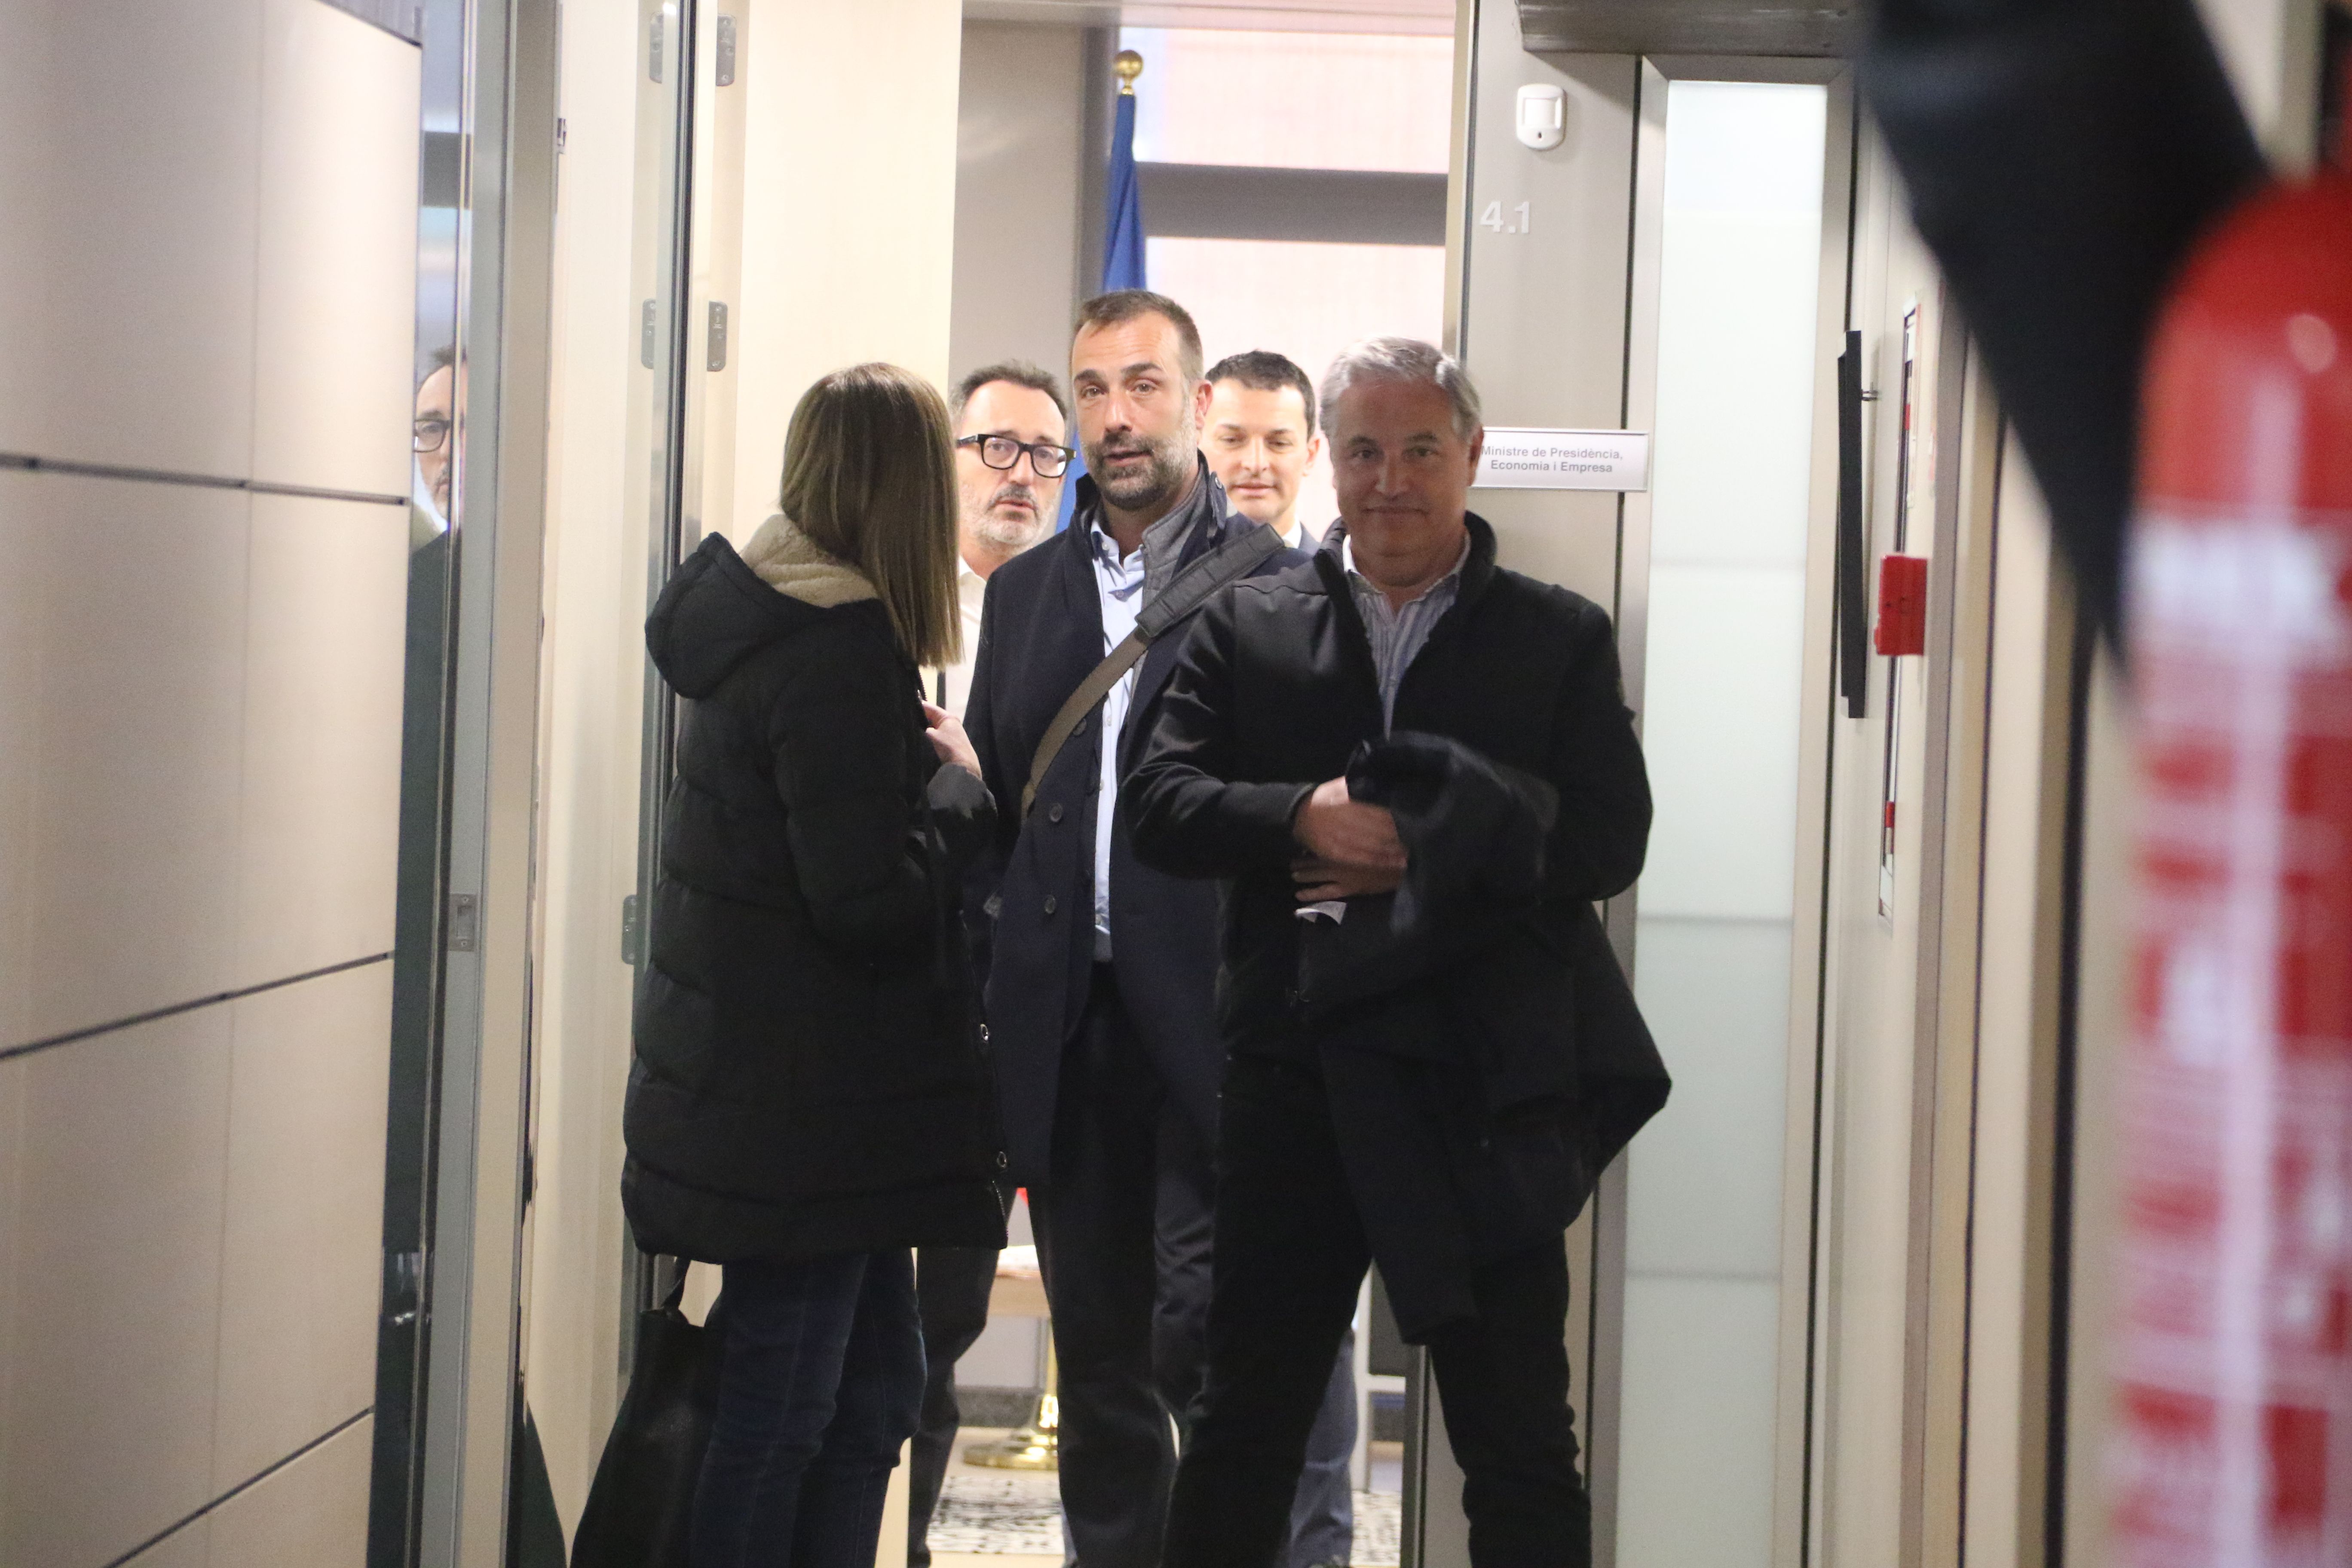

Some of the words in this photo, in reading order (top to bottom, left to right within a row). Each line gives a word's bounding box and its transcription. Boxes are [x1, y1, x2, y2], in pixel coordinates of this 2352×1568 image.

[1480, 201, 1529, 233] 4.1
[1481, 446, 1528, 456] Ministre
[1532, 447, 1546, 457] de
[1551, 448, 1623, 460] Presidència,
[1491, 460, 1549, 471] Economia
[1553, 461, 1556, 471] i
[1561, 462, 1612, 473] Empresa
